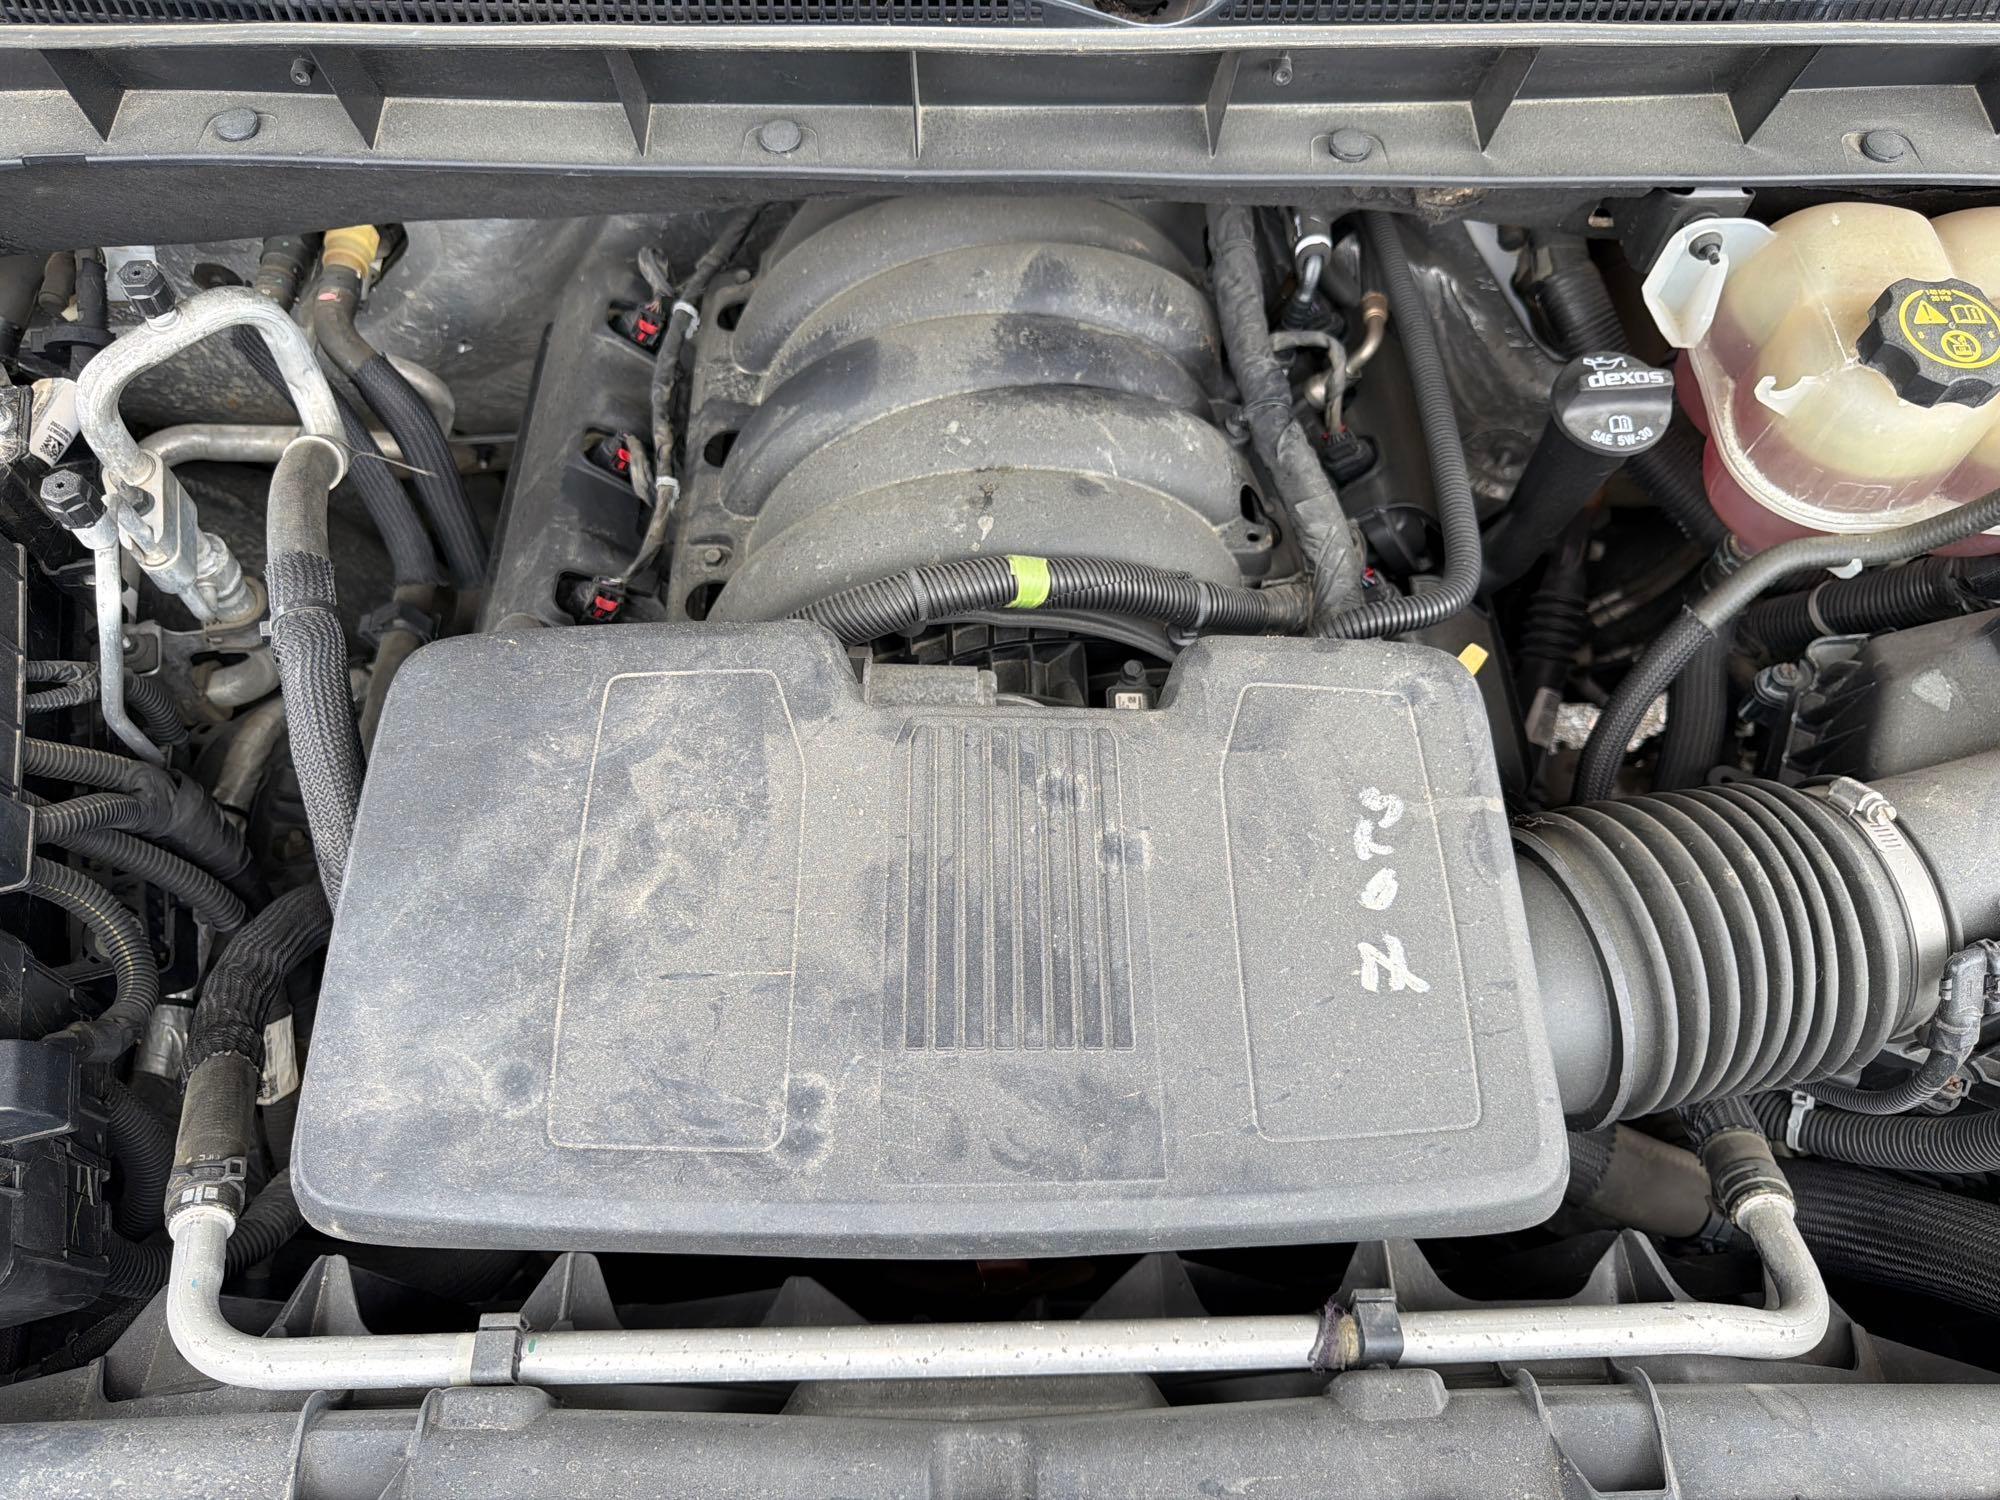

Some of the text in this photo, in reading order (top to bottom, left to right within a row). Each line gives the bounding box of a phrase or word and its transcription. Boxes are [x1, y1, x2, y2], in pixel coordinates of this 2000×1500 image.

[1588, 371, 1664, 387] dexos
[1591, 427, 1653, 446] SAE 5W-30
